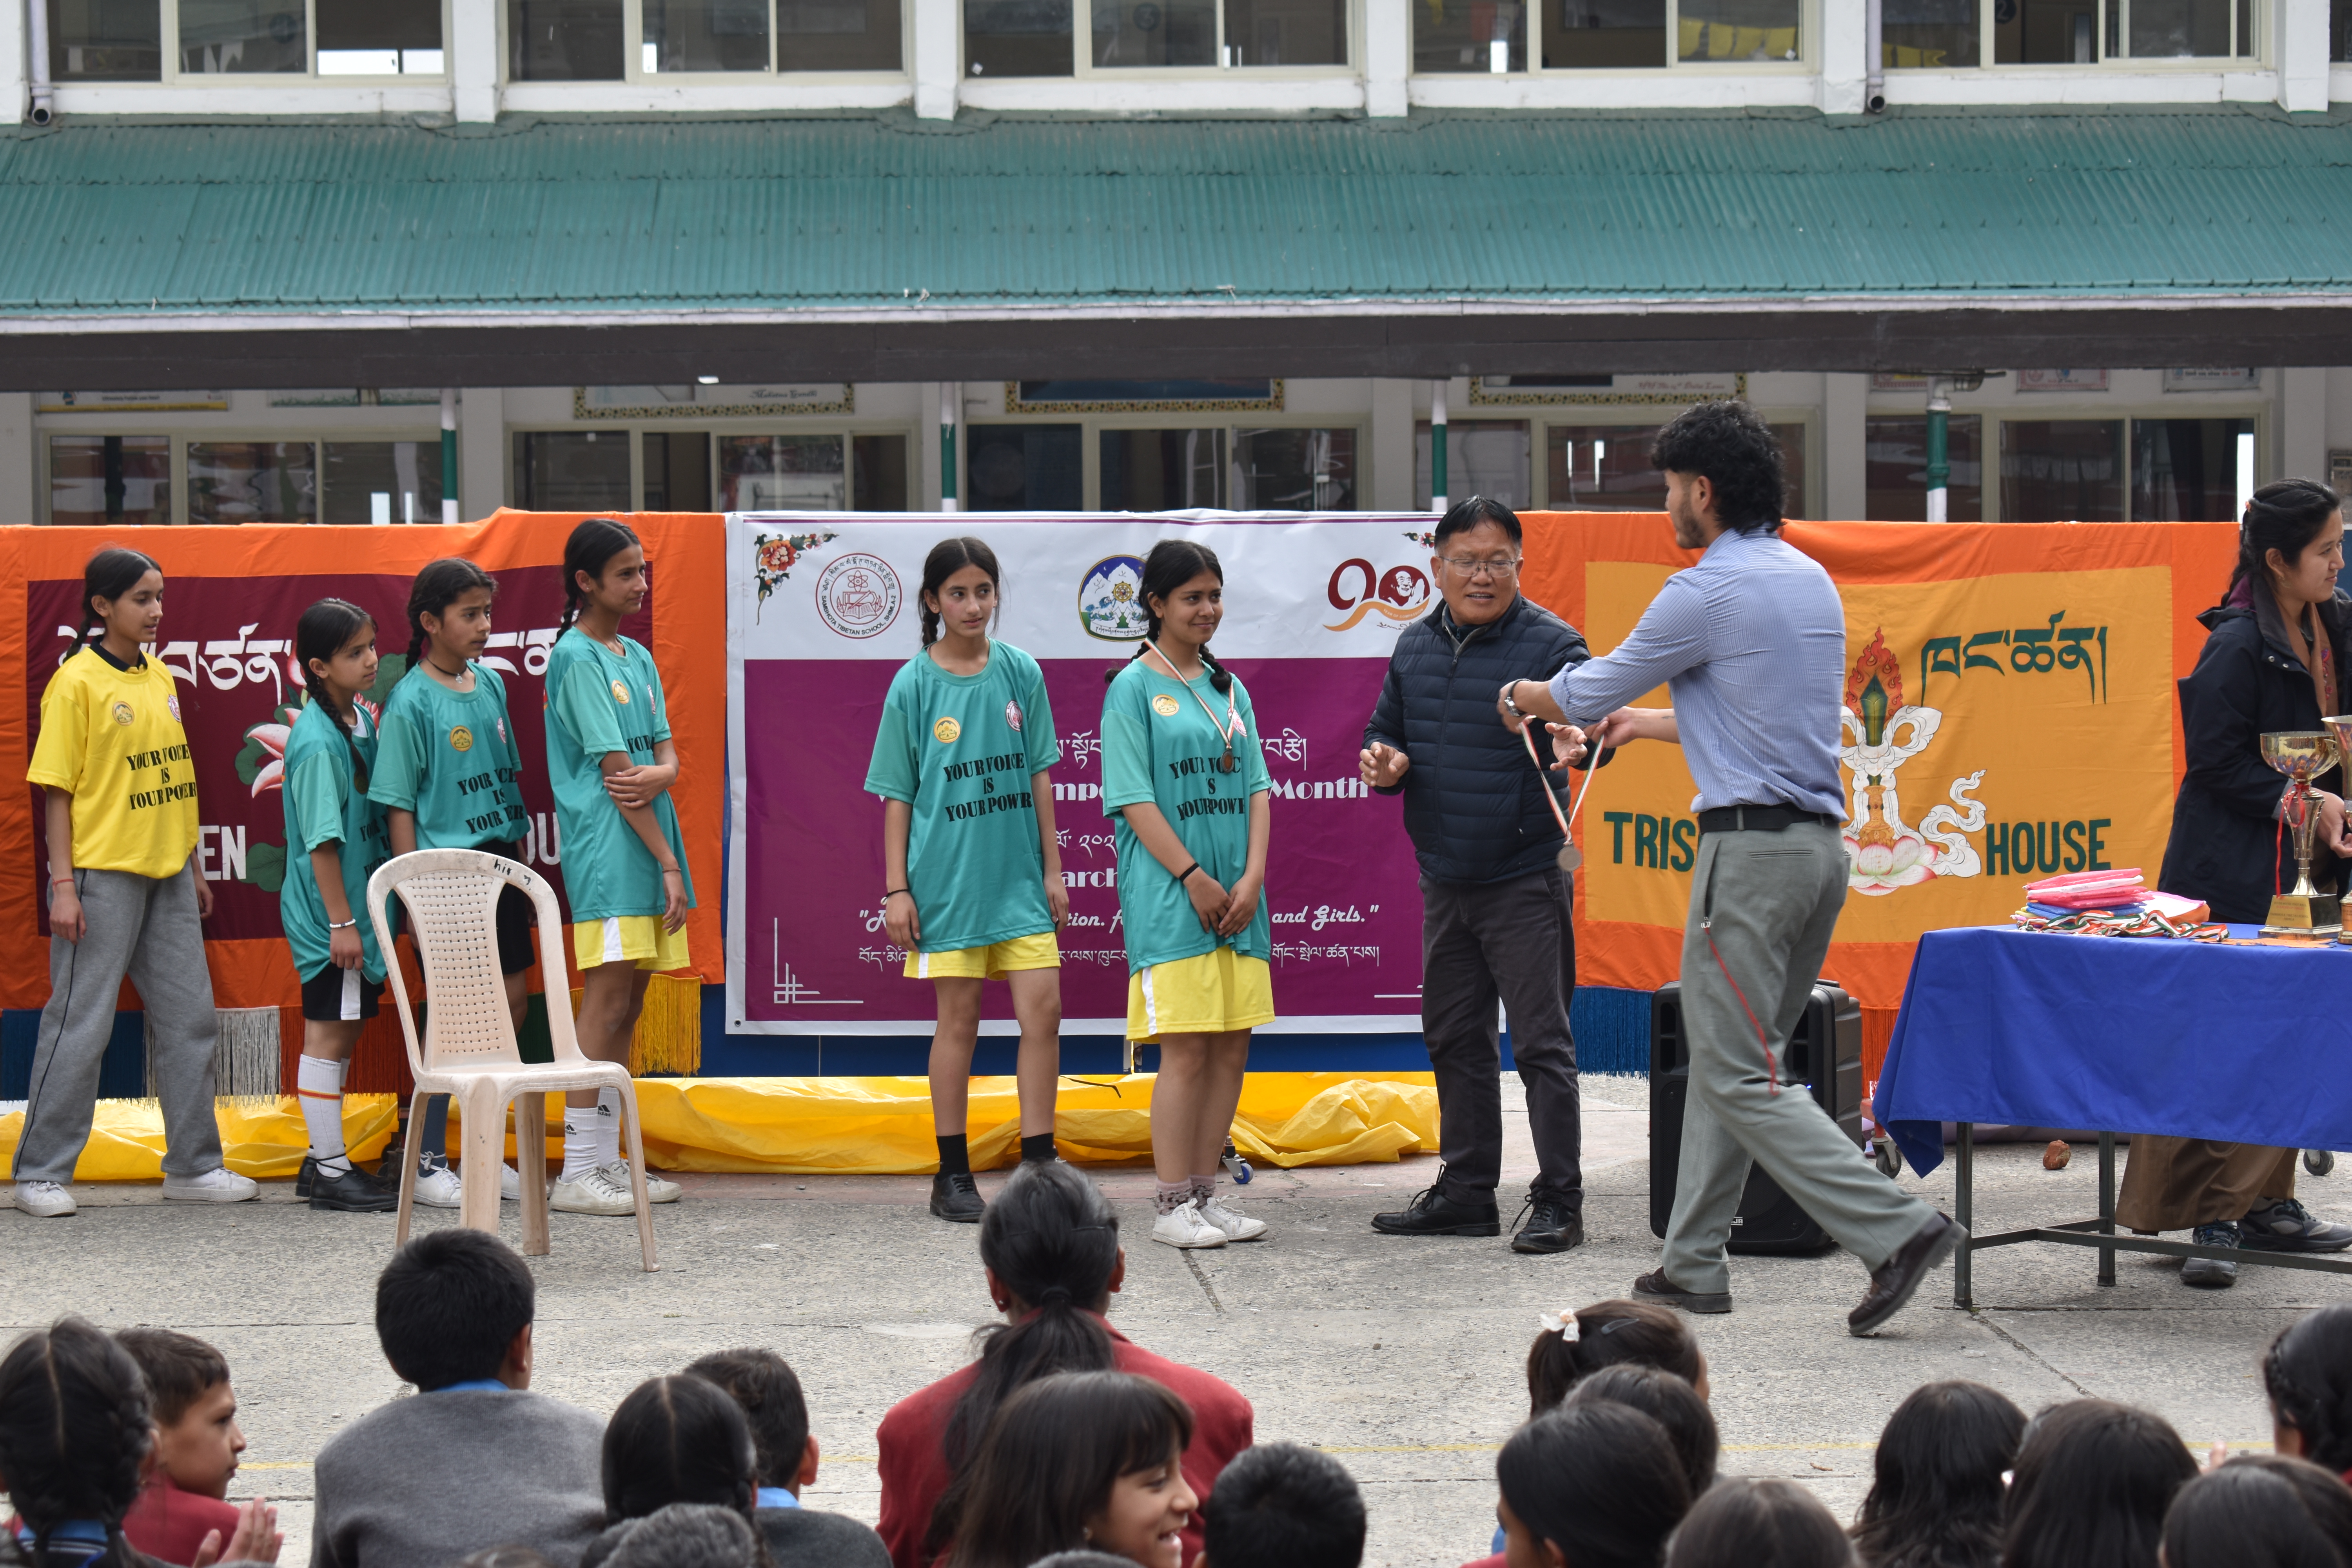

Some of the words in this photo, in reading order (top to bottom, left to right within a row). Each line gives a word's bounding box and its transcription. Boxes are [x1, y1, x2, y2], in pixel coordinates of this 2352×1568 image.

[822, 595, 837, 626] SAMBHOTA
[837, 623, 860, 635] TIBETAN
[862, 621, 887, 635] SCHOOL,
[883, 595, 897, 621] SHIMLA-2
[1383, 608, 1393, 617] YEAR
[1399, 608, 1424, 618] COMPASSION
[126, 750, 162, 771] YOUR
[943, 759, 985, 782] YOUR
[986, 752, 1025, 773] VOICE
[160, 767, 171, 784] IS
[457, 772, 494, 796] YOUR
[983, 777, 995, 795] IS
[1205, 777, 1216, 795] S
[165, 782, 196, 803] POER
[1268, 777, 1368, 800] Month
[945, 799, 986, 822] YOUR
[987, 792, 1033, 813] POWR
[465, 810, 504, 835] YOUR
[1604, 811, 1697, 872] TRIS
[1986, 818, 2112, 876] HOUSE
[1060, 868, 1118, 887] arch
[1066, 912, 1105, 926] tion.
[1272, 906, 1308, 923] and
[1311, 904, 1379, 931] Girls."
